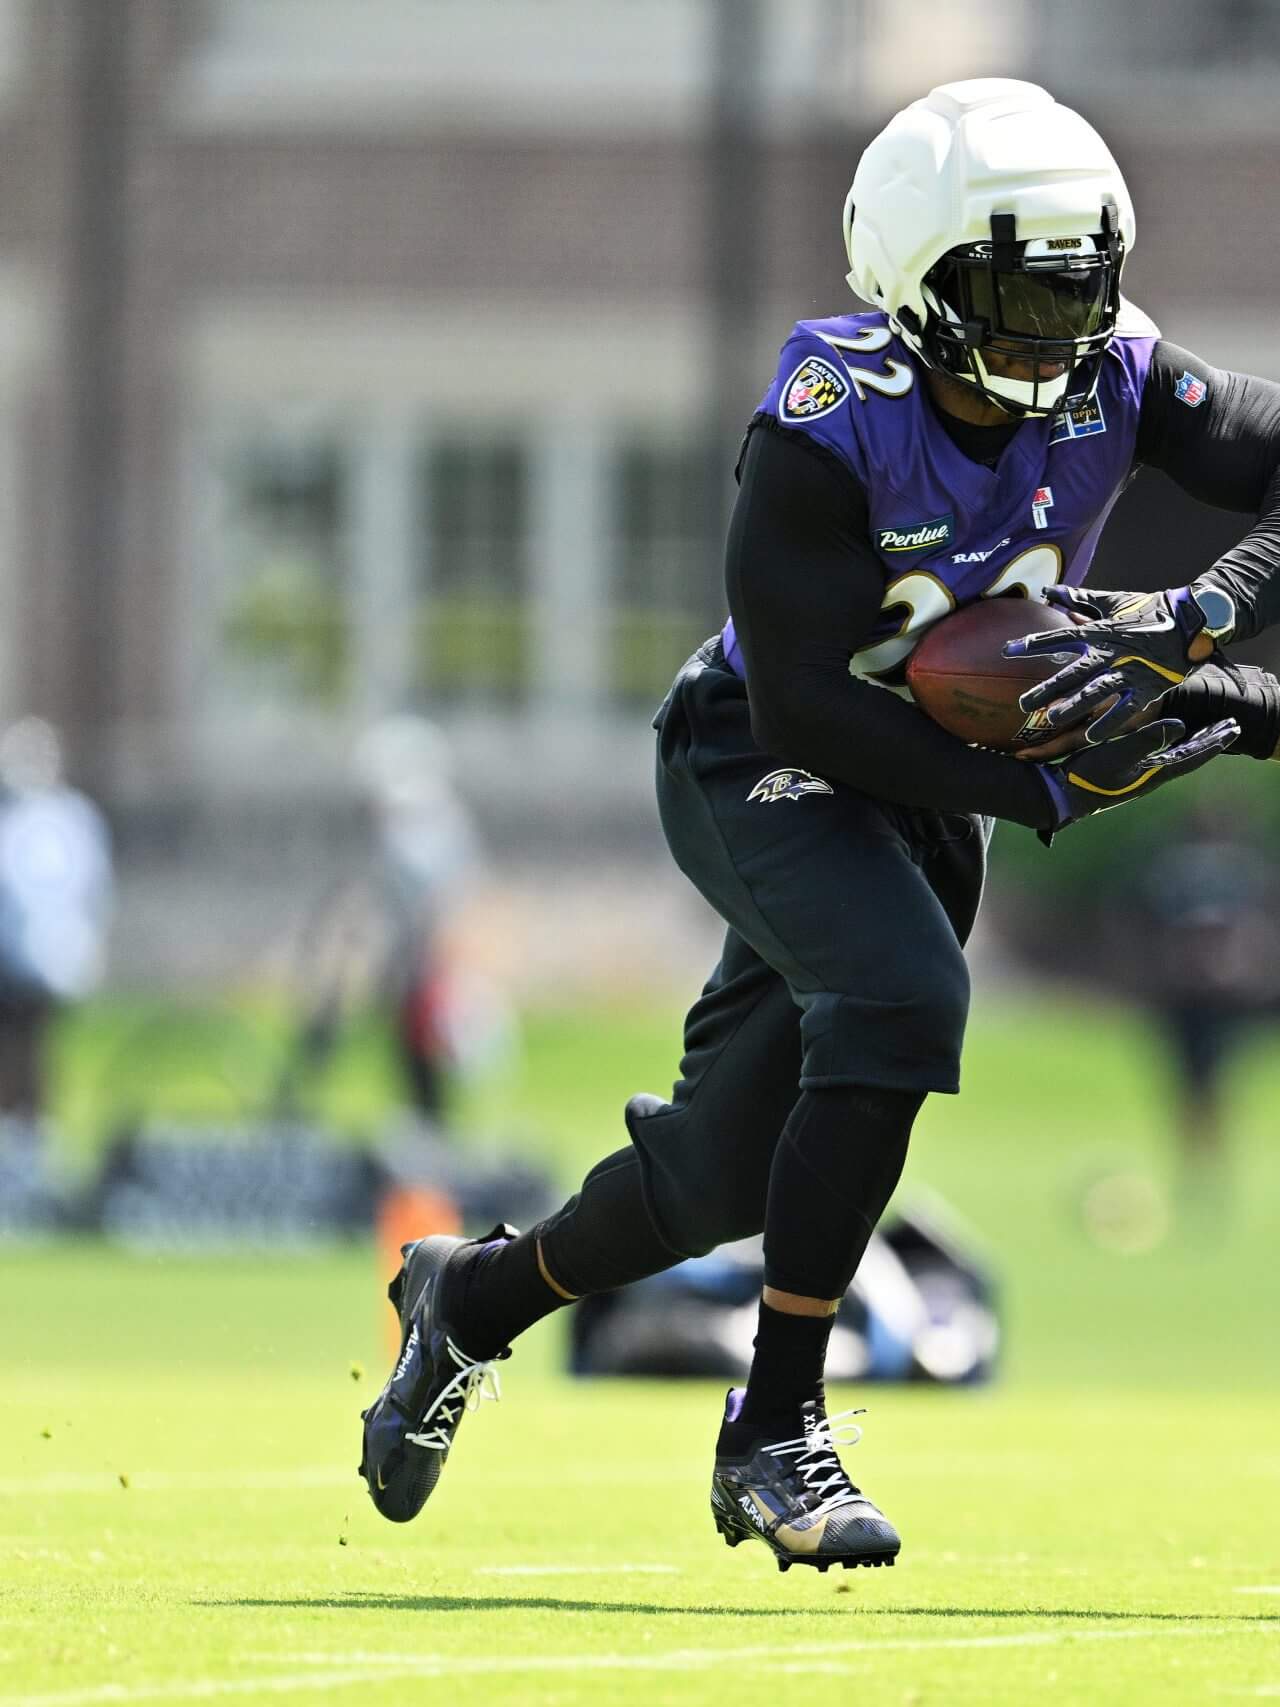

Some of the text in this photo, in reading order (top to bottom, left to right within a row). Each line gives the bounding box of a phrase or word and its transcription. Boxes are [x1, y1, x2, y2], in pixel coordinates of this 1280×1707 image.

[1046, 238, 1081, 250] RAVENS
[808, 361, 843, 393] RAVENS
[880, 525, 948, 547] Perdue
[952, 537, 1011, 564] RAVS
[393, 1323, 419, 1382] ALPHA
[738, 1495, 765, 1533] ALPHA
